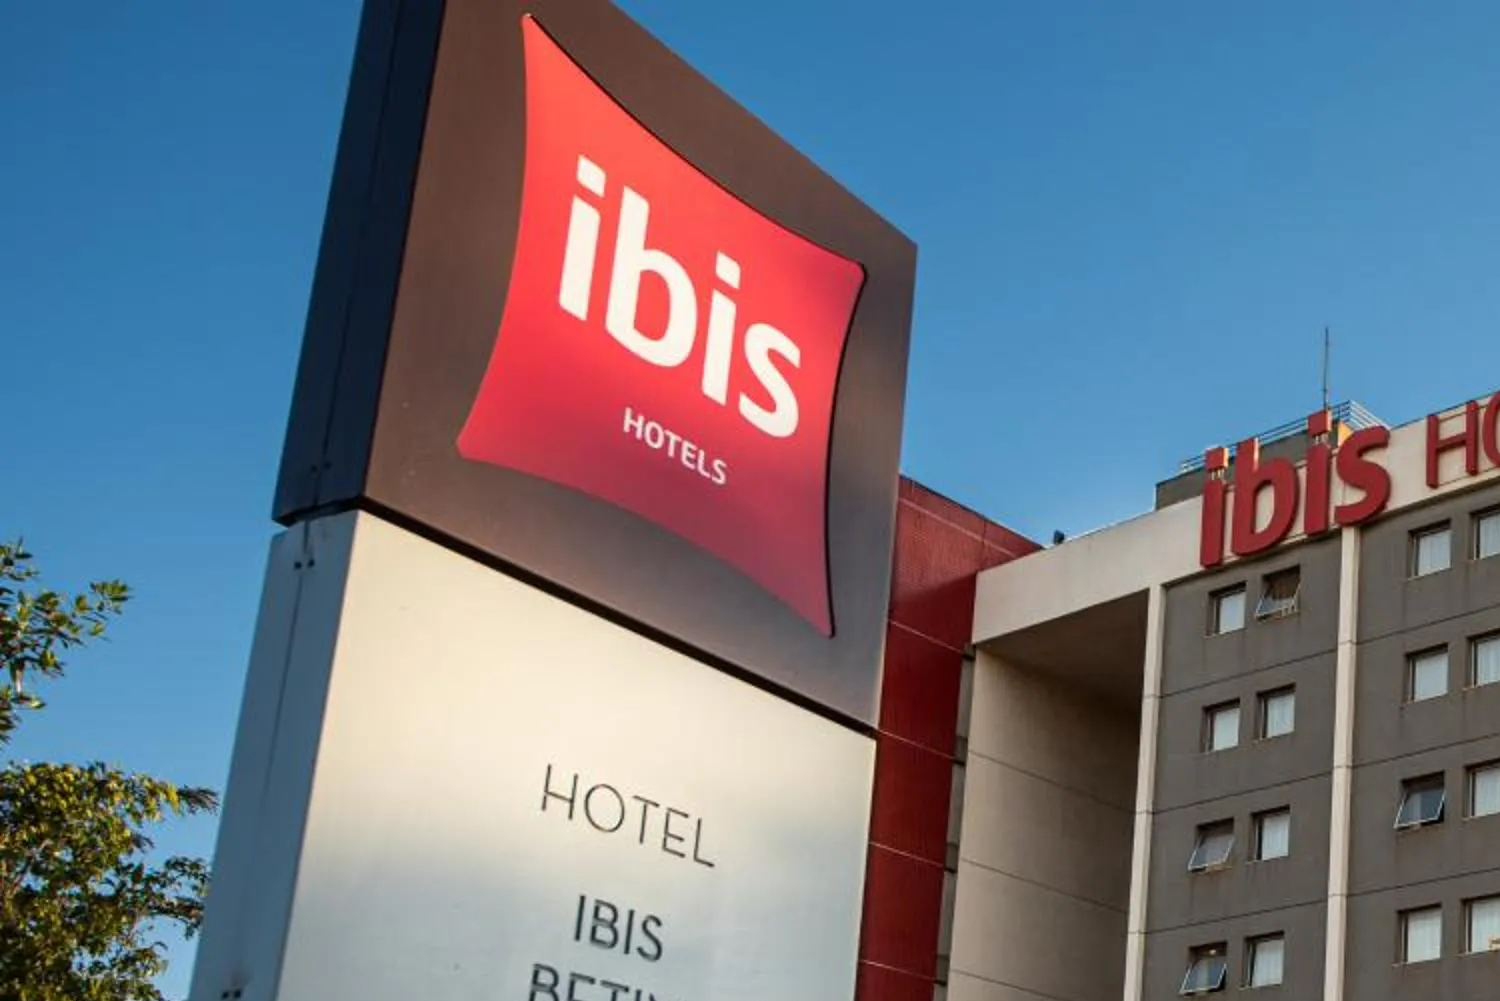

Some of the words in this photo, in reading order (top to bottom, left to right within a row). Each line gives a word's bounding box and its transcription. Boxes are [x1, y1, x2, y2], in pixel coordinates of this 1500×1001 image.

[558, 155, 801, 438] ibis
[623, 406, 727, 485] HOTELS
[1200, 410, 1391, 568] ibis
[541, 763, 715, 868] HOTEL
[573, 895, 664, 962] IBIS
